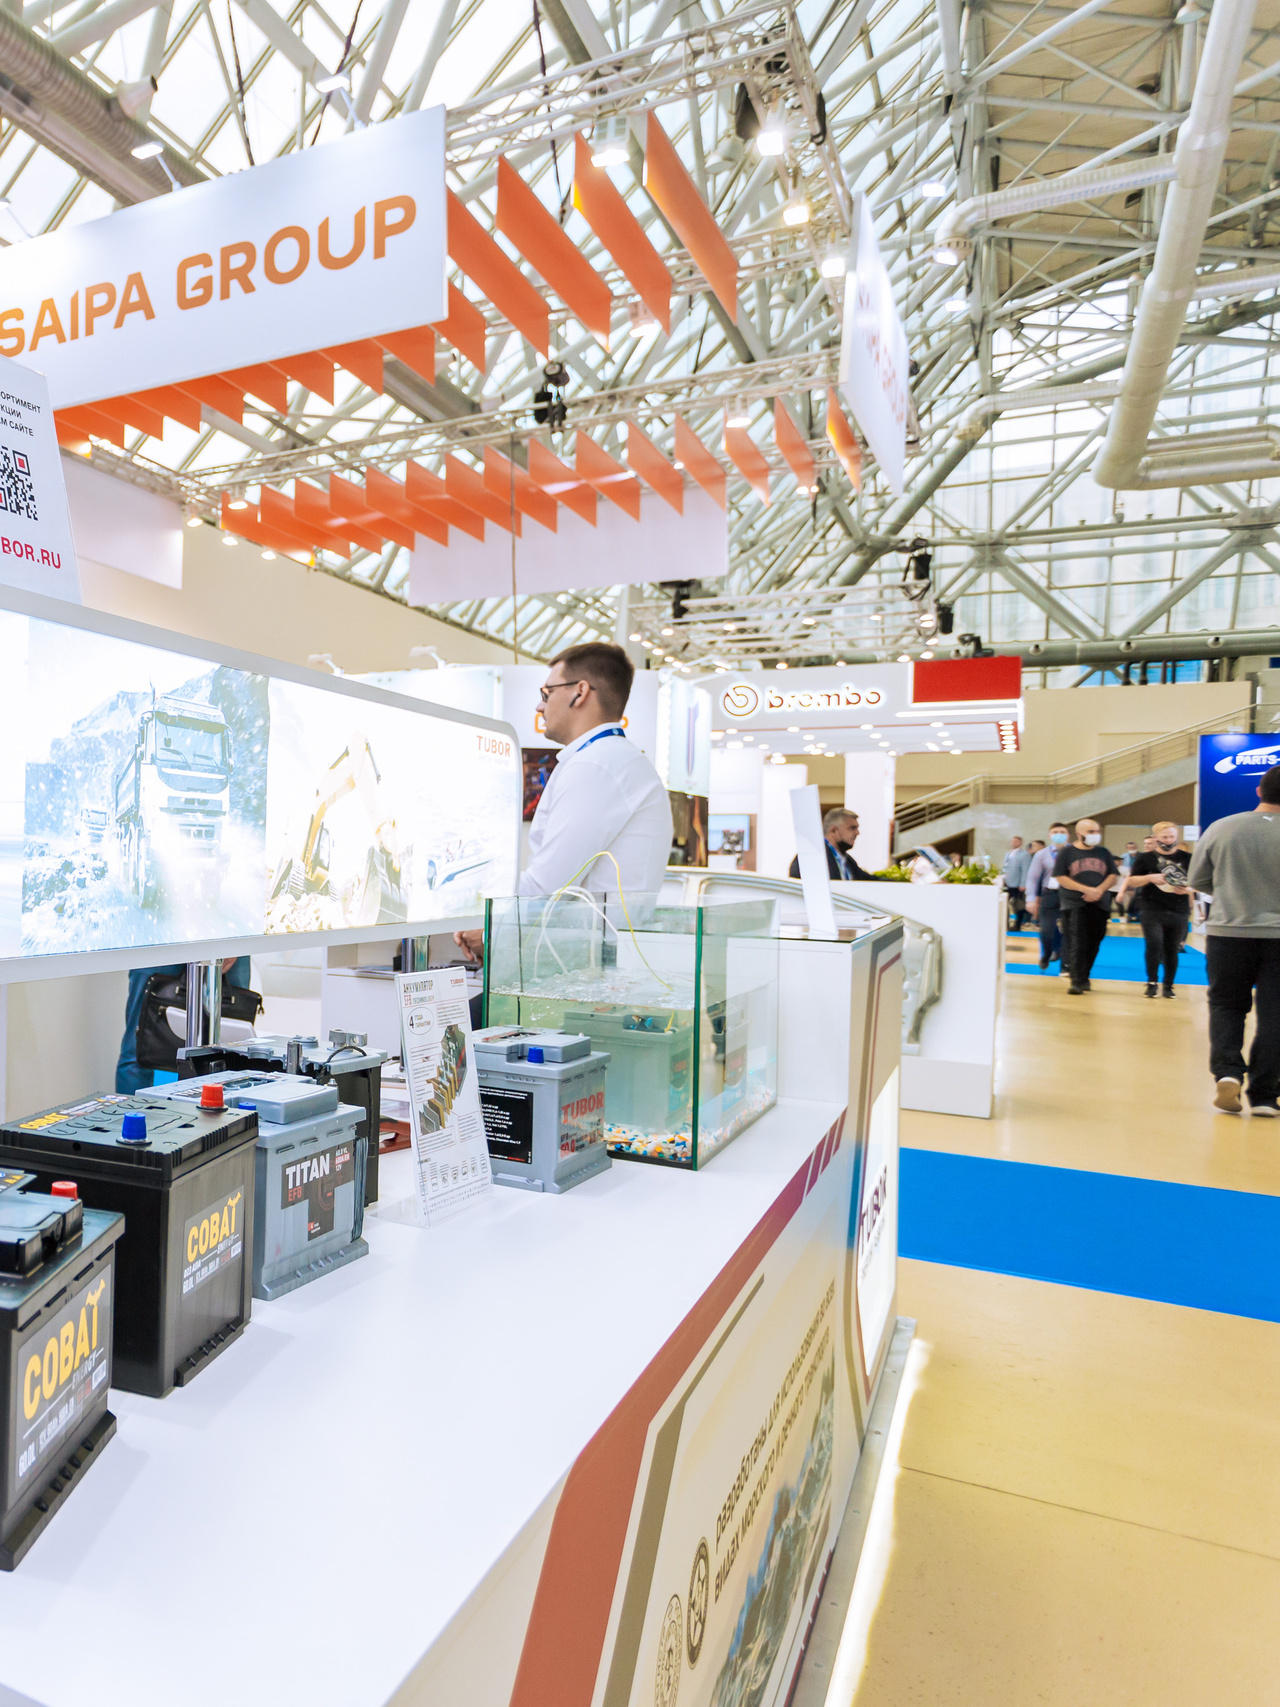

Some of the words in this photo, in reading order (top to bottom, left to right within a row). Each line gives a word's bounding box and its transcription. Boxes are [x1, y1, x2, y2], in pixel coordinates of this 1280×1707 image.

[176, 194, 417, 311] GROUP
[9, 418, 34, 437] САЙТЕ
[768, 686, 882, 709] brembo
[476, 735, 511, 758] TUBOR
[409, 1015, 414, 1029] 4
[561, 1091, 605, 1124] TUBOR
[285, 1153, 330, 1190] TITAN
[288, 1186, 303, 1202] EFB
[187, 1191, 242, 1263] COBAT
[23, 1278, 106, 1421] COBAT
[71, 1350, 97, 1392] ENERGY
[716, 1416, 768, 1555] разработаны
[768, 1391, 780, 1435] для
[714, 1525, 741, 1605] видах
[741, 1448, 775, 1543] морского
[775, 1434, 781, 1462] и
[781, 1384, 804, 1457] речного
